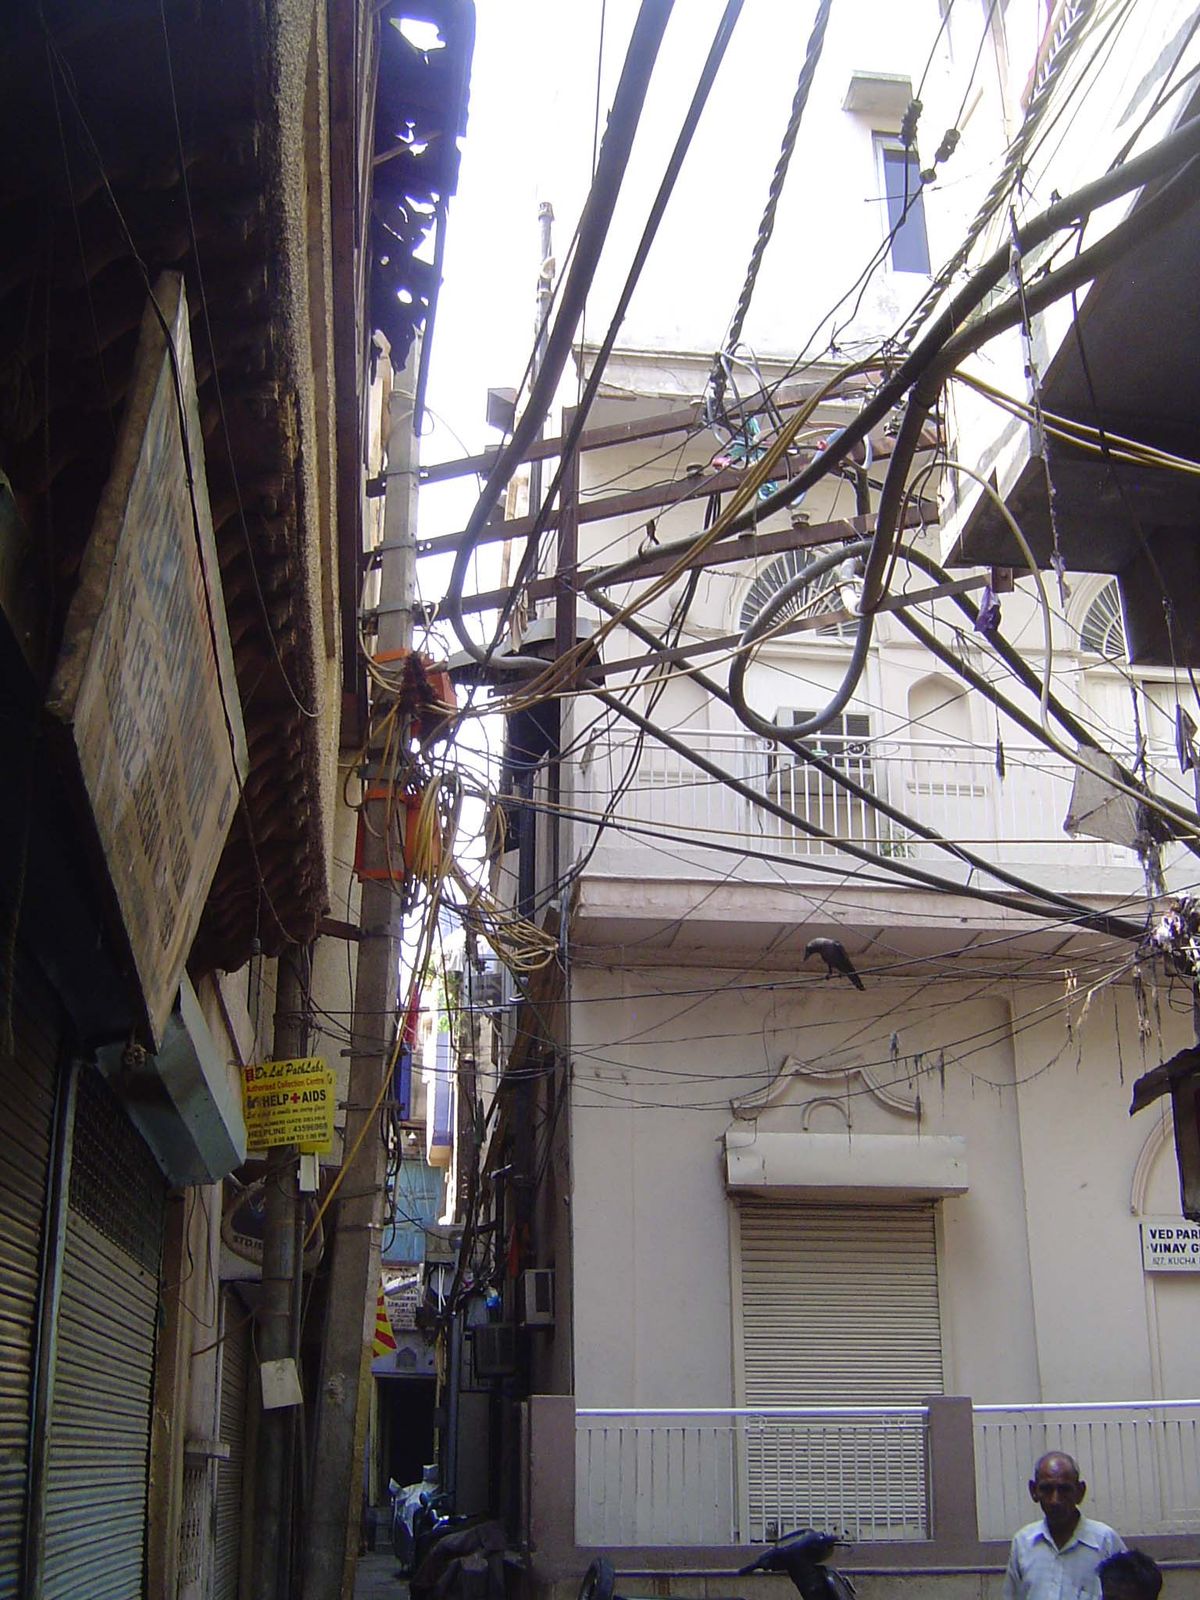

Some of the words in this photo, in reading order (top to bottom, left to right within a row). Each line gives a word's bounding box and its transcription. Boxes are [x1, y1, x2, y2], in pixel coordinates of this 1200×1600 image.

[262, 1093, 289, 1108] HELP
[302, 1090, 326, 1103] AIDS
[1149, 1229, 1174, 1240] VED
[1176, 1229, 1200, 1240] PAR
[1150, 1243, 1187, 1254] VINAY
[1191, 1243, 1200, 1254] G
